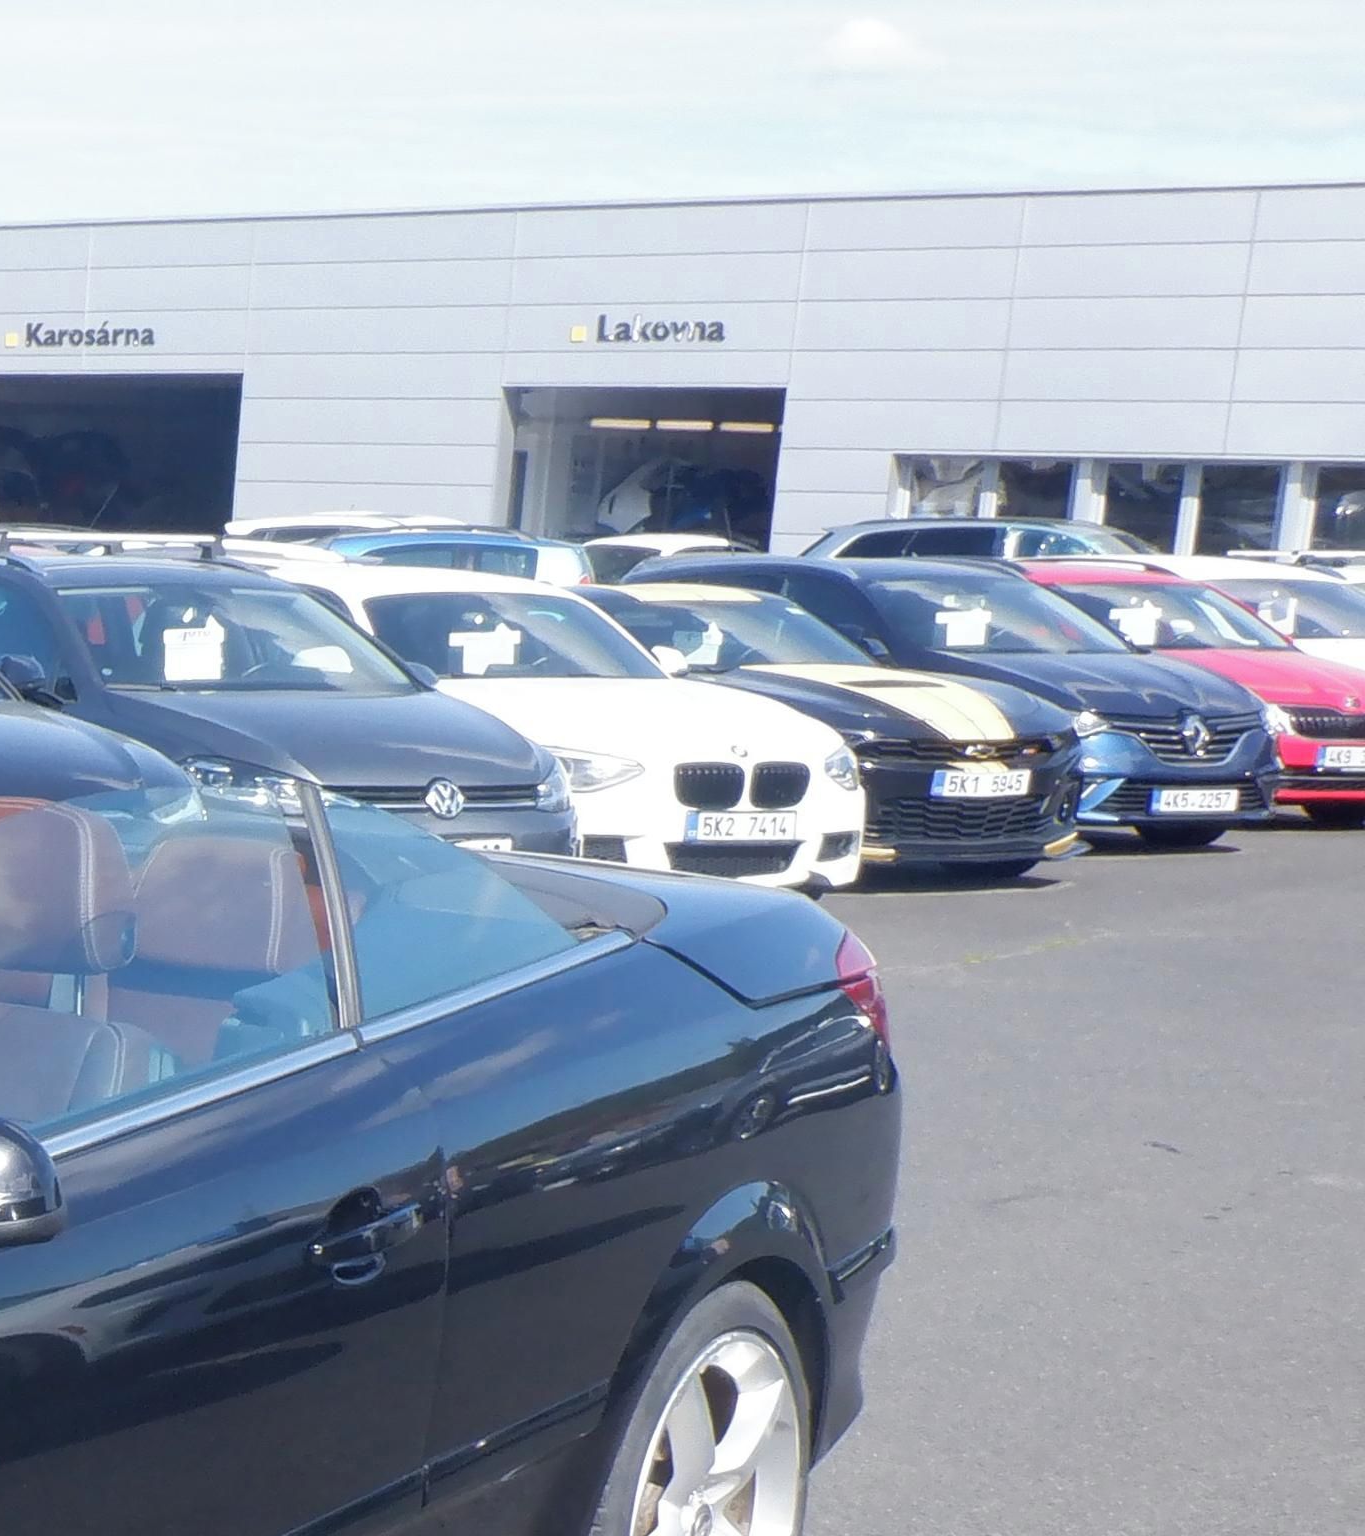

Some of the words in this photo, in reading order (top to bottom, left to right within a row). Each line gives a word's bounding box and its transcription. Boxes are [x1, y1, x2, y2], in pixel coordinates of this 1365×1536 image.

[25, 320, 155, 347] Karosárna
[596, 313, 726, 342] Lakovna
[703, 816, 736, 836] 5K2
[749, 816, 787, 836] 7414
